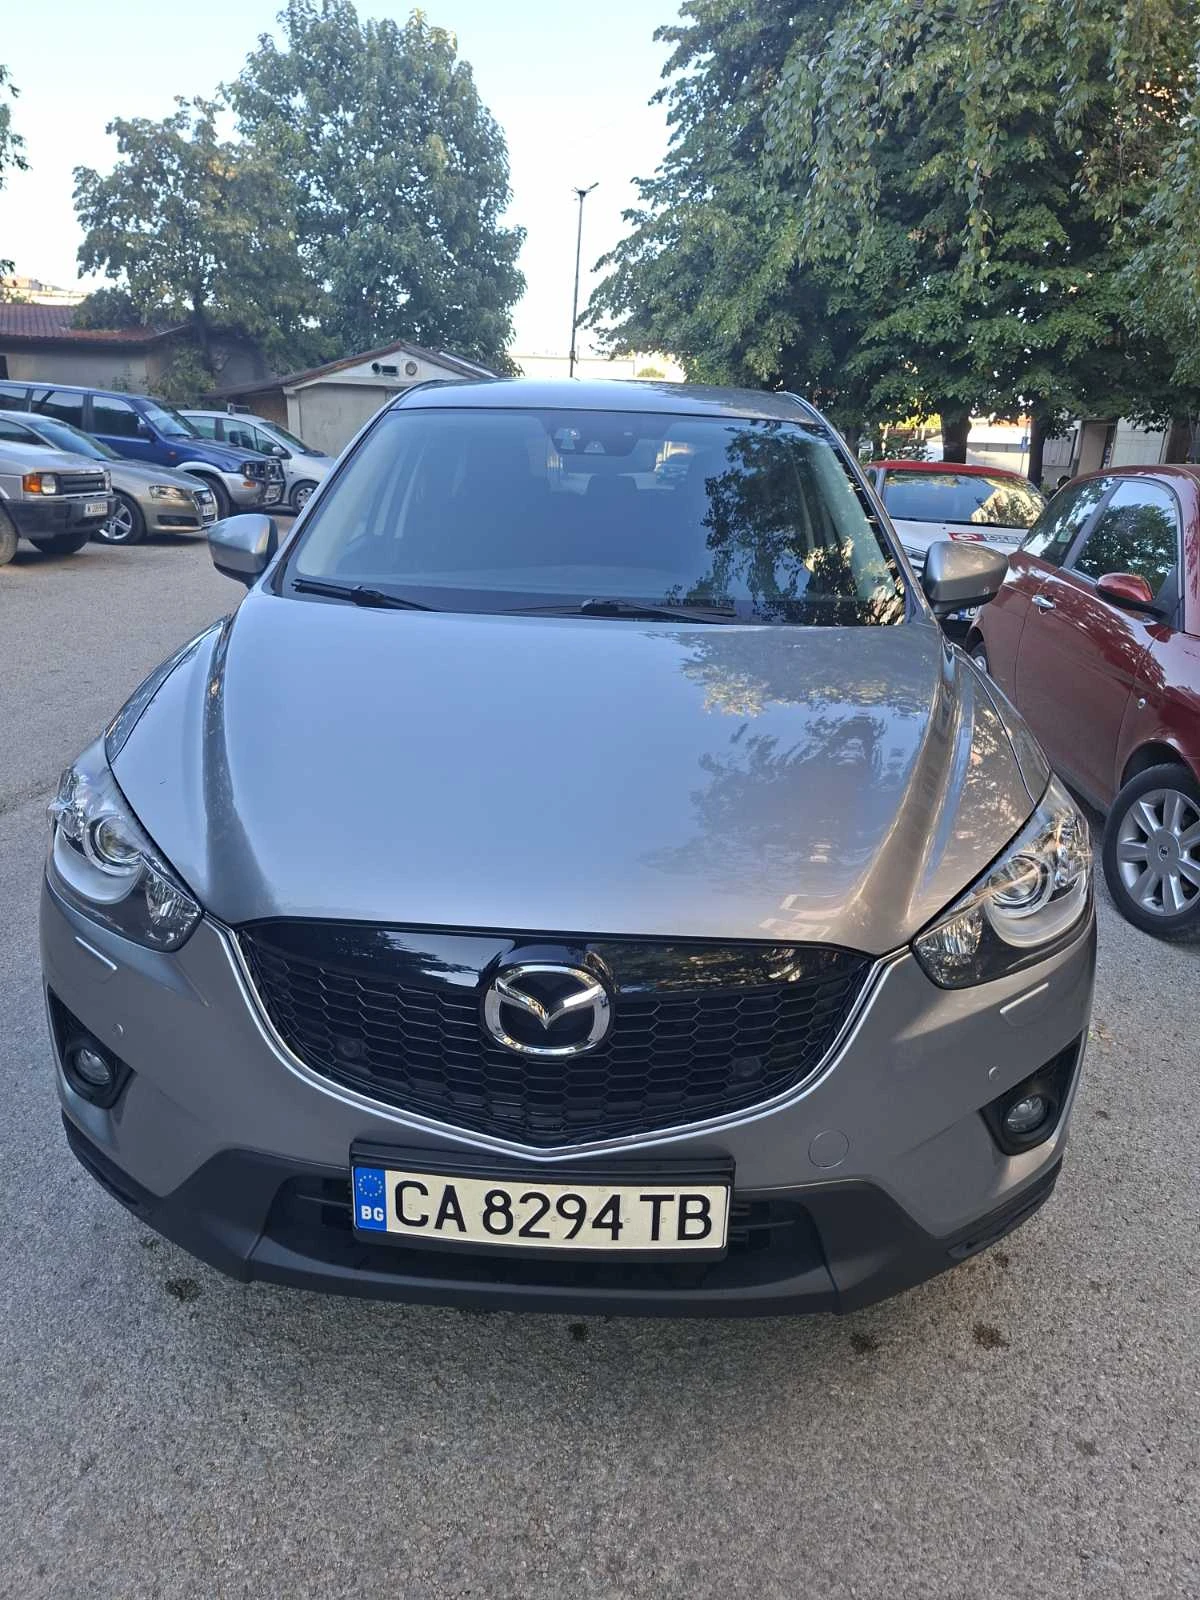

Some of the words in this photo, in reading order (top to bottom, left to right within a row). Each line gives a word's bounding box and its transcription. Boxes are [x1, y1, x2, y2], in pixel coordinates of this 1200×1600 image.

[361, 1205, 384, 1222] BG
[394, 1180, 467, 1233] CA
[482, 1189, 624, 1240] 8294
[639, 1194, 712, 1241] TB
